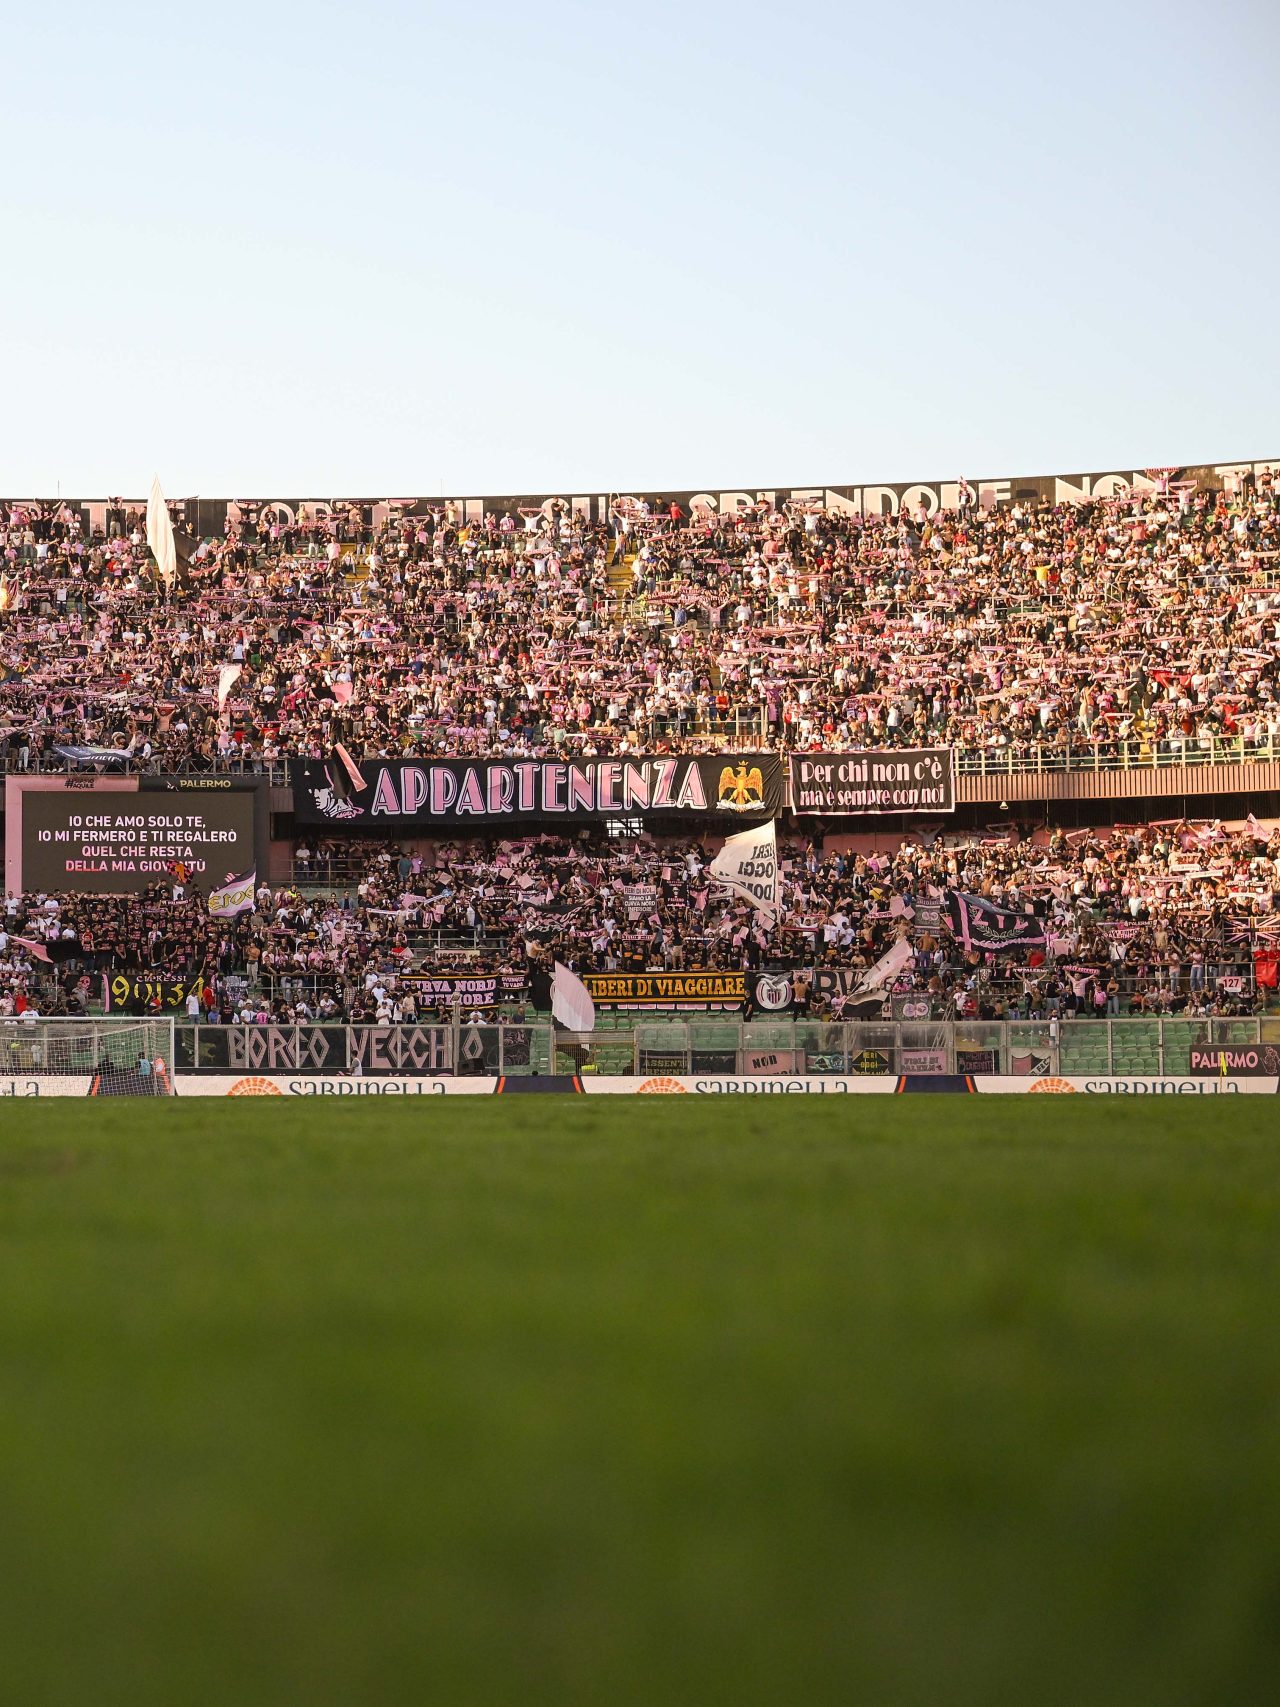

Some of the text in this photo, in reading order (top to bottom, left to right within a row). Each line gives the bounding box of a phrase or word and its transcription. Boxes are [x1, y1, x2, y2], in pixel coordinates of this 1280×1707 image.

[800, 761, 834, 783] Per
[838, 759, 868, 783] chi
[872, 762, 910, 783] non
[179, 780, 232, 788] PALERMO
[371, 758, 708, 816] APPARTENENZA
[799, 784, 945, 806] ma è sempre con noi
[69, 816, 206, 829] IO CHE AMO SOLO TE,
[38, 829, 237, 842] IO MI FERMERÒ E TI REGALERÒ
[82, 846, 193, 857] QUEL CHE RESTA
[65, 859, 206, 872] DELLA MIA GIOVNTÙ
[454, 978, 496, 992] NORD
[636, 978, 653, 997] DI
[655, 976, 746, 996] VIAGGIARE
[1223, 978, 1239, 988] 127
[228, 1028, 330, 1068] BORGO
[349, 1028, 484, 1068] VECCHO
